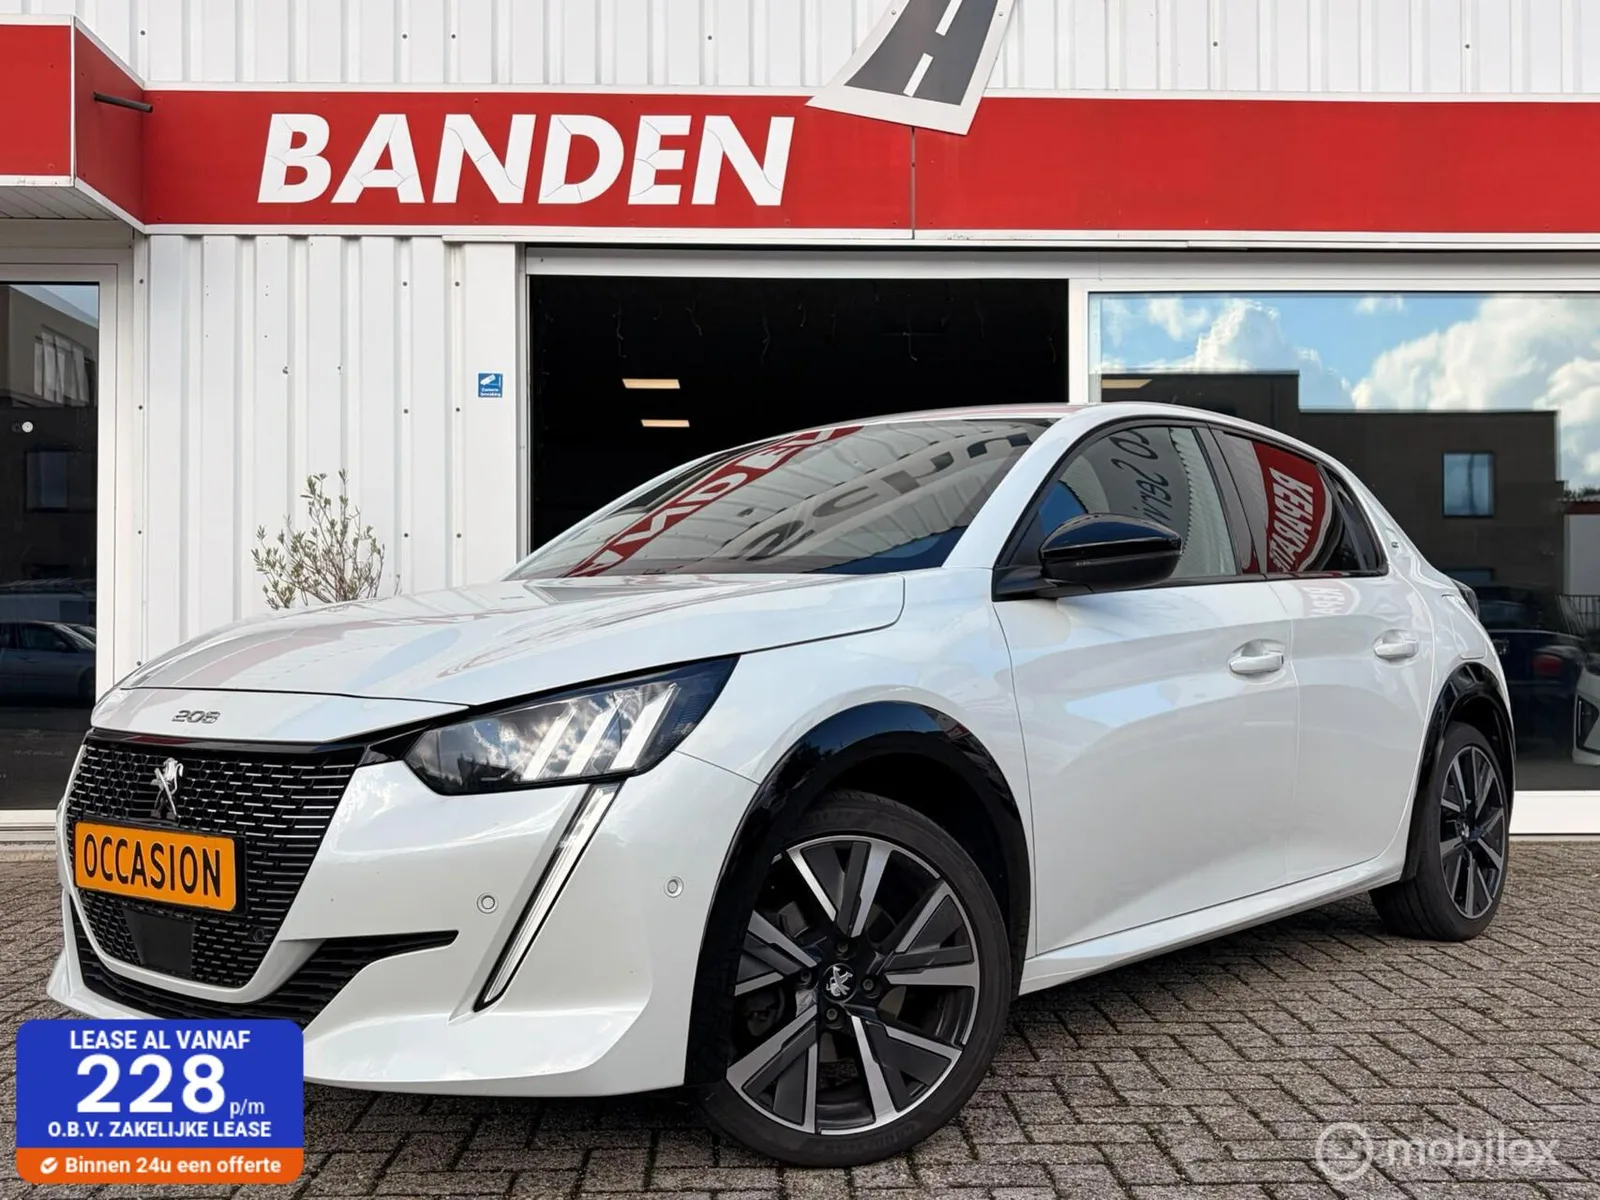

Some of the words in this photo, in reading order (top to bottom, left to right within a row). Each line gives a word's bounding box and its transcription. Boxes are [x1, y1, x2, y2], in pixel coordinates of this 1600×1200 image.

[258, 113, 795, 206] BANDEN
[171, 709, 220, 724] 208
[83, 833, 221, 898] OCCASION
